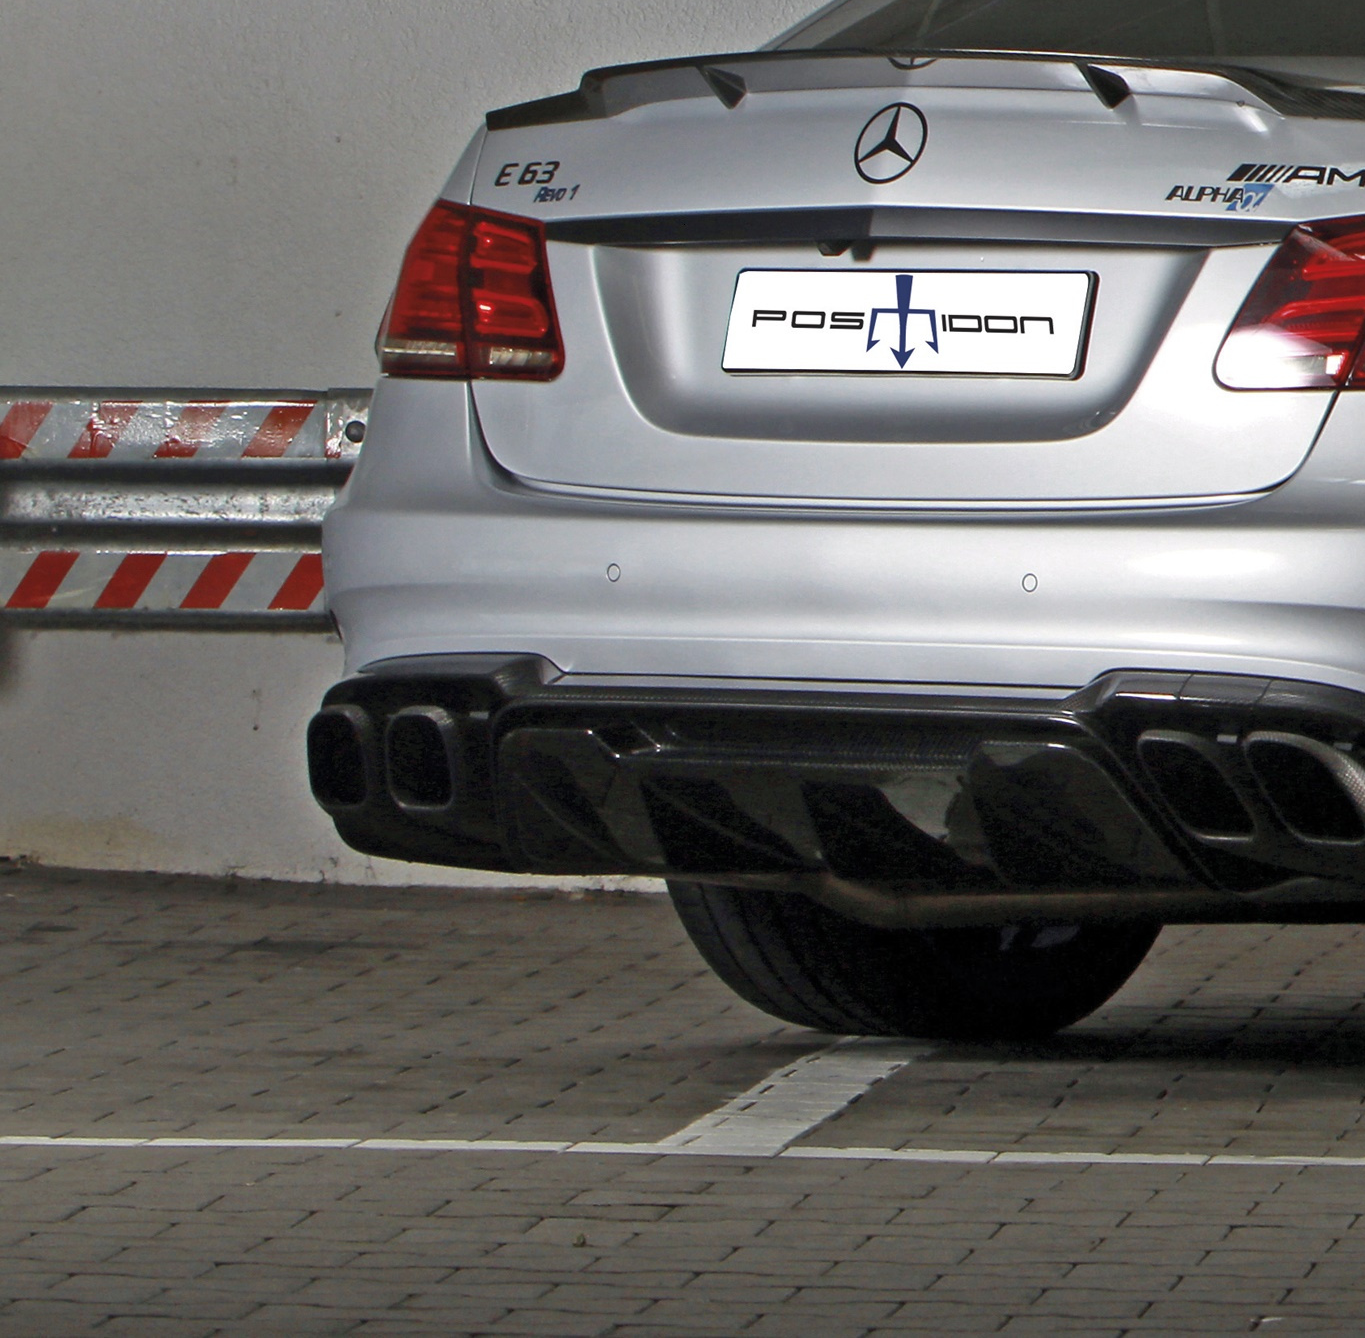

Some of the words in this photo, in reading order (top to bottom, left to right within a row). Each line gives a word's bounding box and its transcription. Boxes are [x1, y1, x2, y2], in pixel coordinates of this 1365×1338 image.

[495, 162, 520, 187] E
[517, 160, 561, 186] 63
[568, 183, 581, 202] 1
